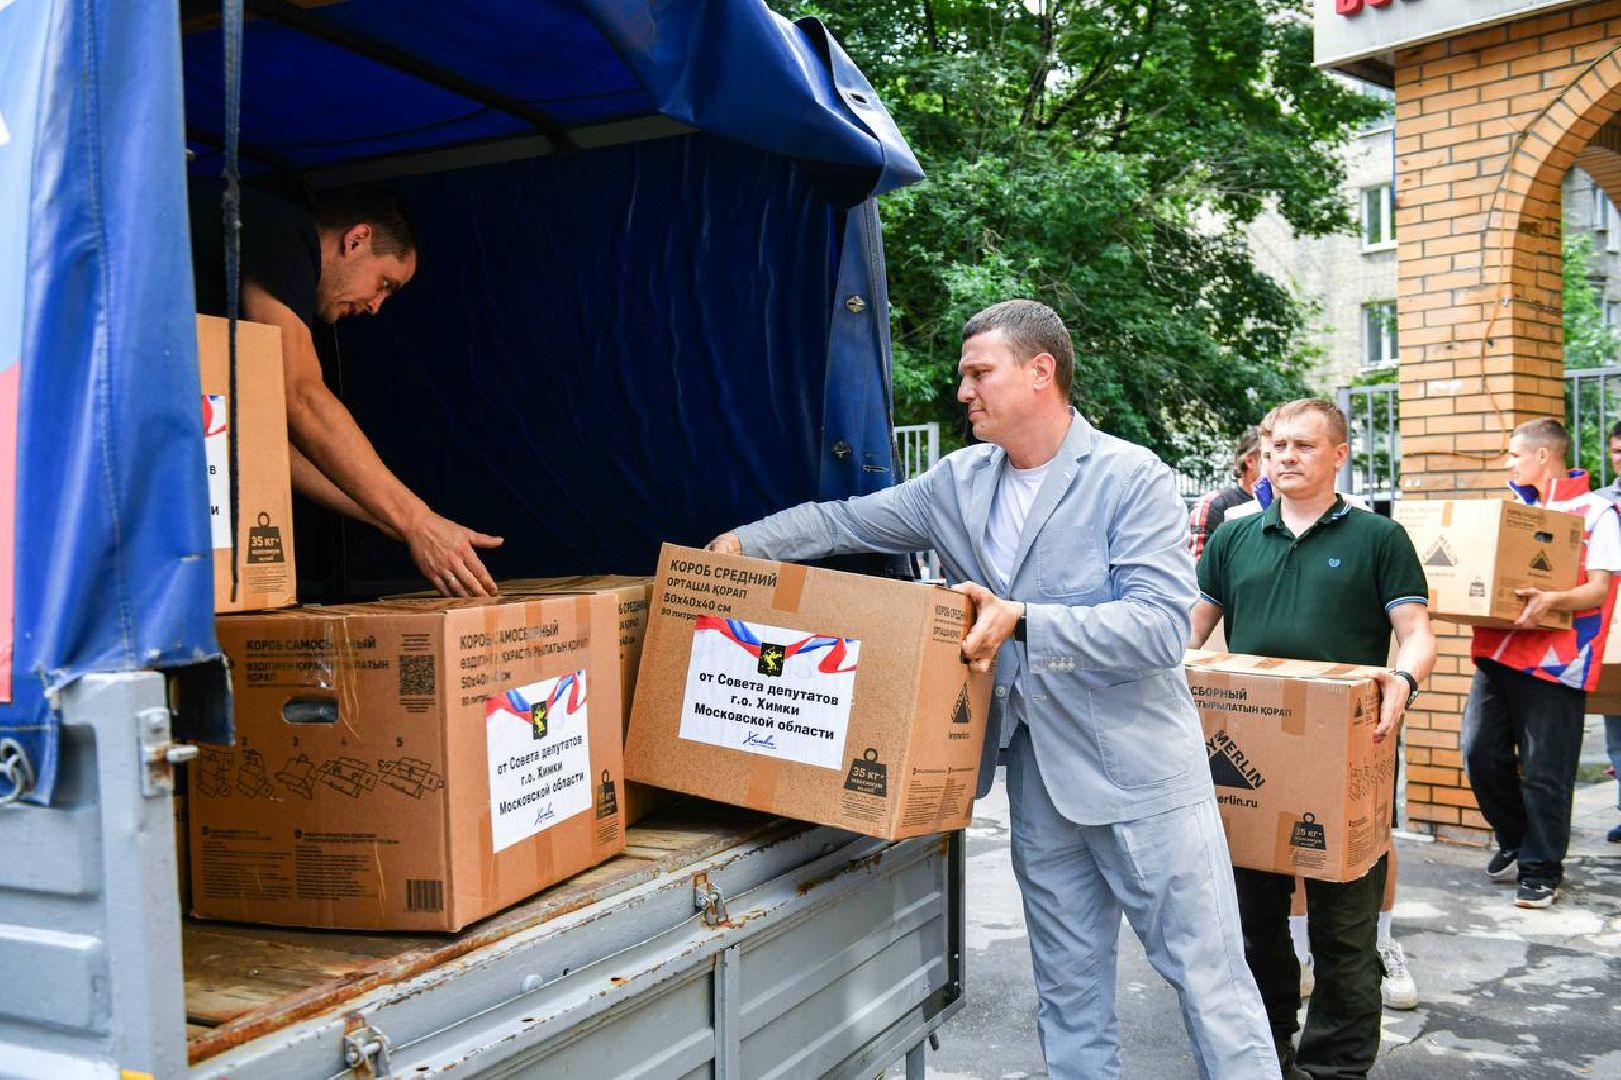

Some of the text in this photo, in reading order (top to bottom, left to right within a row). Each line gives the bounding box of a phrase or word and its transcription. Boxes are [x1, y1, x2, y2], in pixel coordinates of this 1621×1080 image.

[251, 536, 263, 547] 35
[670, 559, 778, 588] КОРОБ СРЕДНИЙ
[667, 577, 710, 593] ОРТАША
[285, 635, 376, 650] САМОСБЫЙ
[460, 620, 559, 651] КОРОБ АМОСБРНЫЙ
[699, 672, 839, 706] от Совета депутатов
[1190, 685, 1248, 701] СБОРНЫЙ
[730, 695, 800, 716] г.о. Химки
[695, 702, 774, 729] Московской
[777, 720, 835, 740] области
[396, 737, 404, 747] 5
[497, 735, 583, 775] от Совета депутатов
[1213, 730, 1266, 789] MERLIN
[537, 762, 563, 779] Химки
[852, 766, 867, 779] 35
[499, 782, 550, 816] Московской
[552, 771, 584, 792] области
[1217, 795, 1258, 809] erlin.ru
